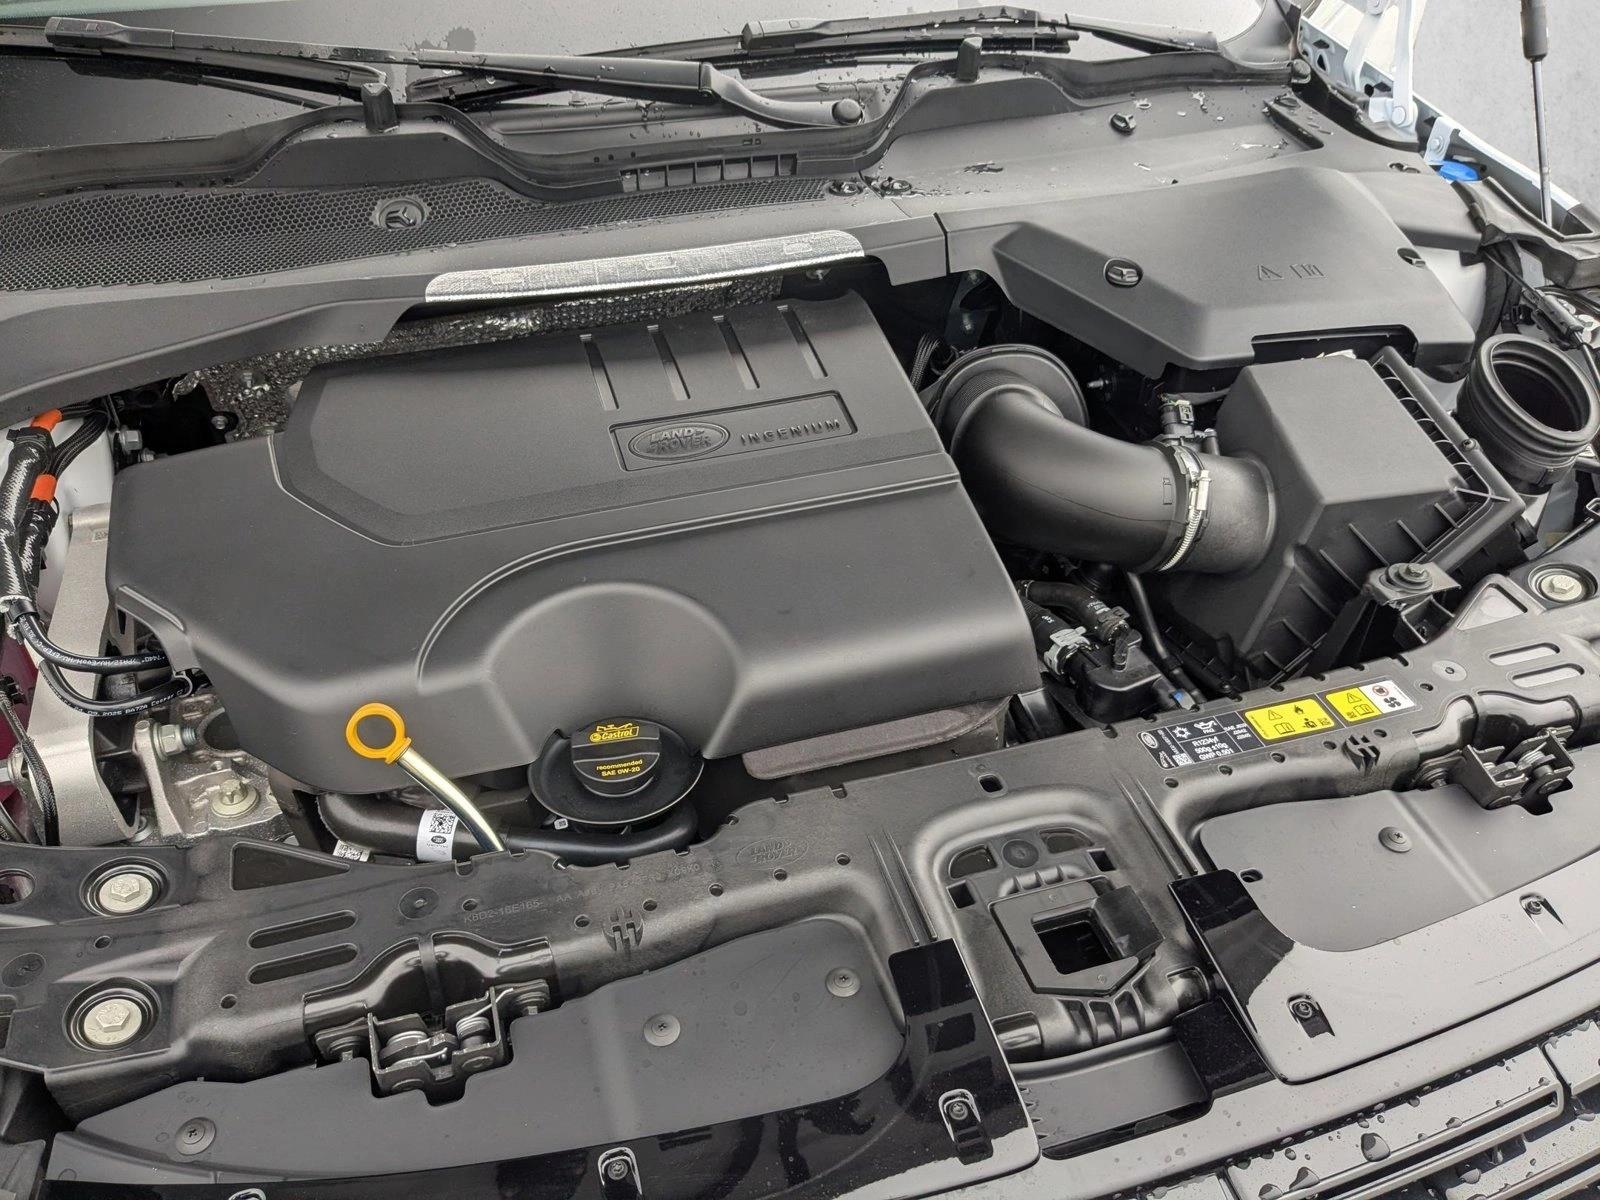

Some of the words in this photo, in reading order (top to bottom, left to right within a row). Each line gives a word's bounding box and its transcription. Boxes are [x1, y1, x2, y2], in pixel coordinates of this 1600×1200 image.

[650, 428, 697, 444] LAND
[740, 418, 841, 446] INGENIUM
[601, 729, 633, 740] Castrol
[1192, 736, 1219, 747] R1234yf
[1199, 751, 1216, 761] GWP
[596, 759, 643, 770] recommended
[617, 766, 641, 775] 0W-20
